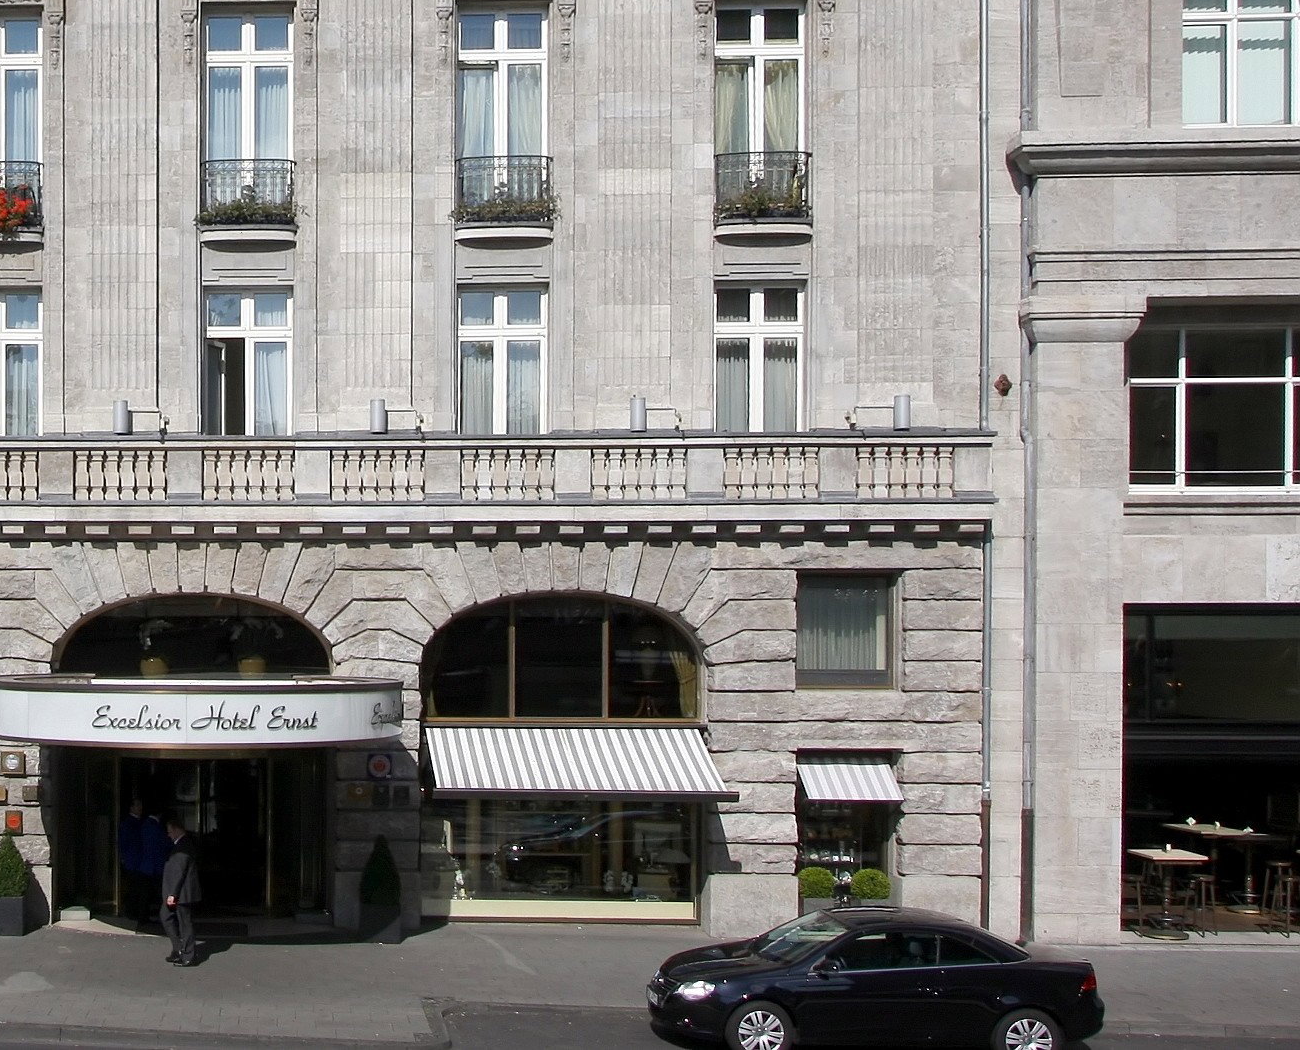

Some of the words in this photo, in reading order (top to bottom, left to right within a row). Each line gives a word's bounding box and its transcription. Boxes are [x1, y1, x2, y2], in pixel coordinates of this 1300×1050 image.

[92, 704, 182, 730] Excelsior
[190, 700, 261, 731] Hotel
[266, 704, 319, 730] Ernst
